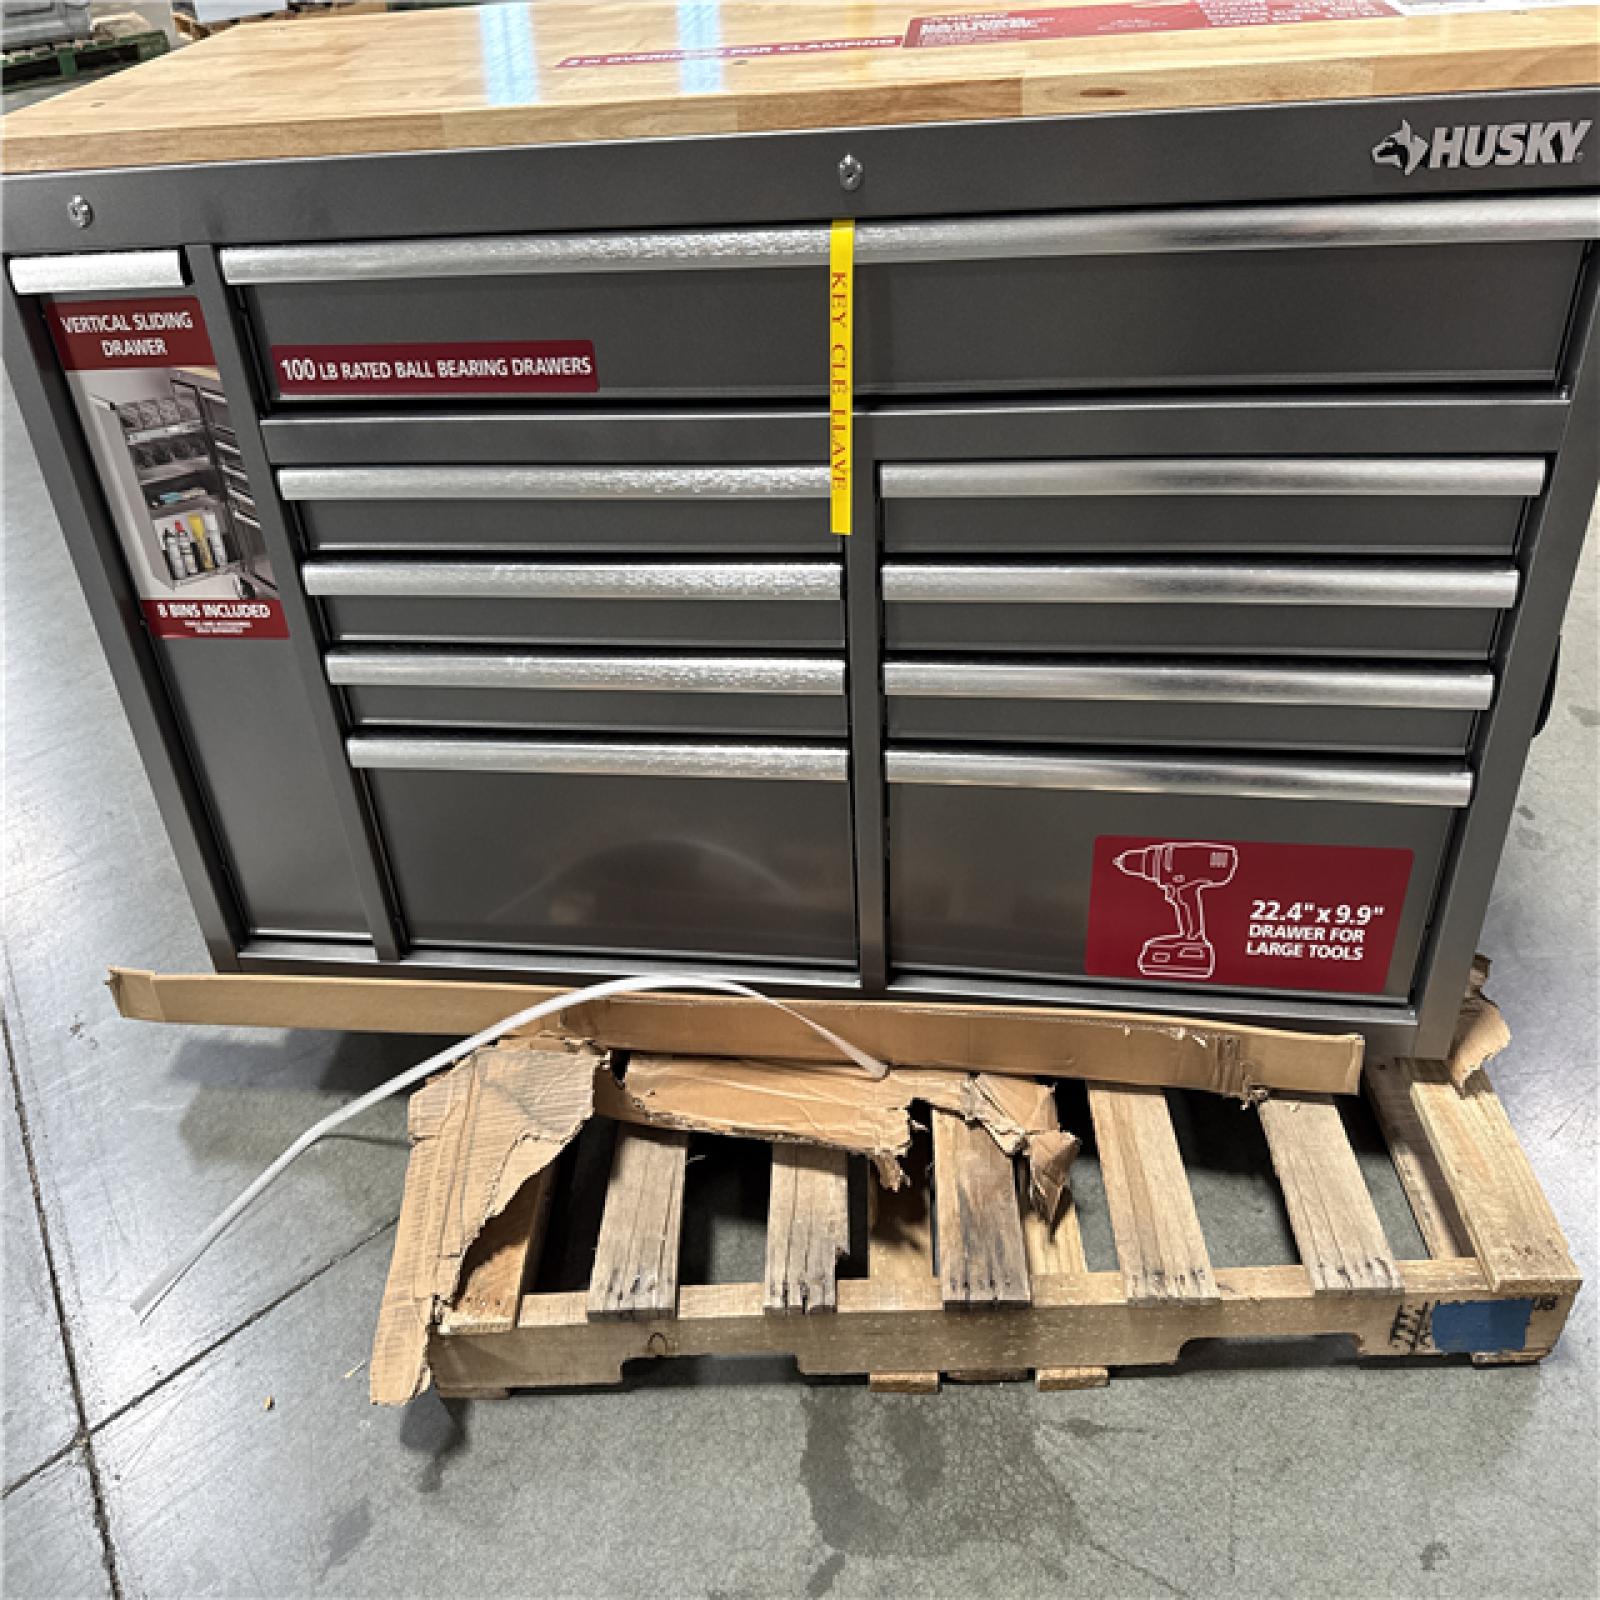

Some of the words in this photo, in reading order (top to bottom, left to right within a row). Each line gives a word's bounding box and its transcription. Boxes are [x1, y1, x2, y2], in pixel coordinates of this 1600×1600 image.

[1429, 119, 1593, 169] HUSKY
[831, 271, 849, 329] KEY
[60, 313, 133, 333] VERTICAL
[132, 311, 194, 331] SLIDING
[101, 338, 168, 357] DRAWER
[280, 356, 316, 381] 100
[318, 361, 339, 381] LB
[341, 360, 393, 380] RATED
[394, 359, 435, 379] BALL
[436, 358, 508, 378] BEARING
[511, 355, 593, 377] DRAWERS
[831, 408, 849, 491] LLAVE
[168, 602, 201, 618] BINS
[202, 602, 271, 618] INCLUDED
[1334, 903, 1386, 926] 9.9"
[1248, 922, 1326, 942] DRAWER
[1329, 926, 1366, 943] FOR
[1245, 940, 1304, 959] LARGE
[1308, 944, 1364, 962] TOOLS
